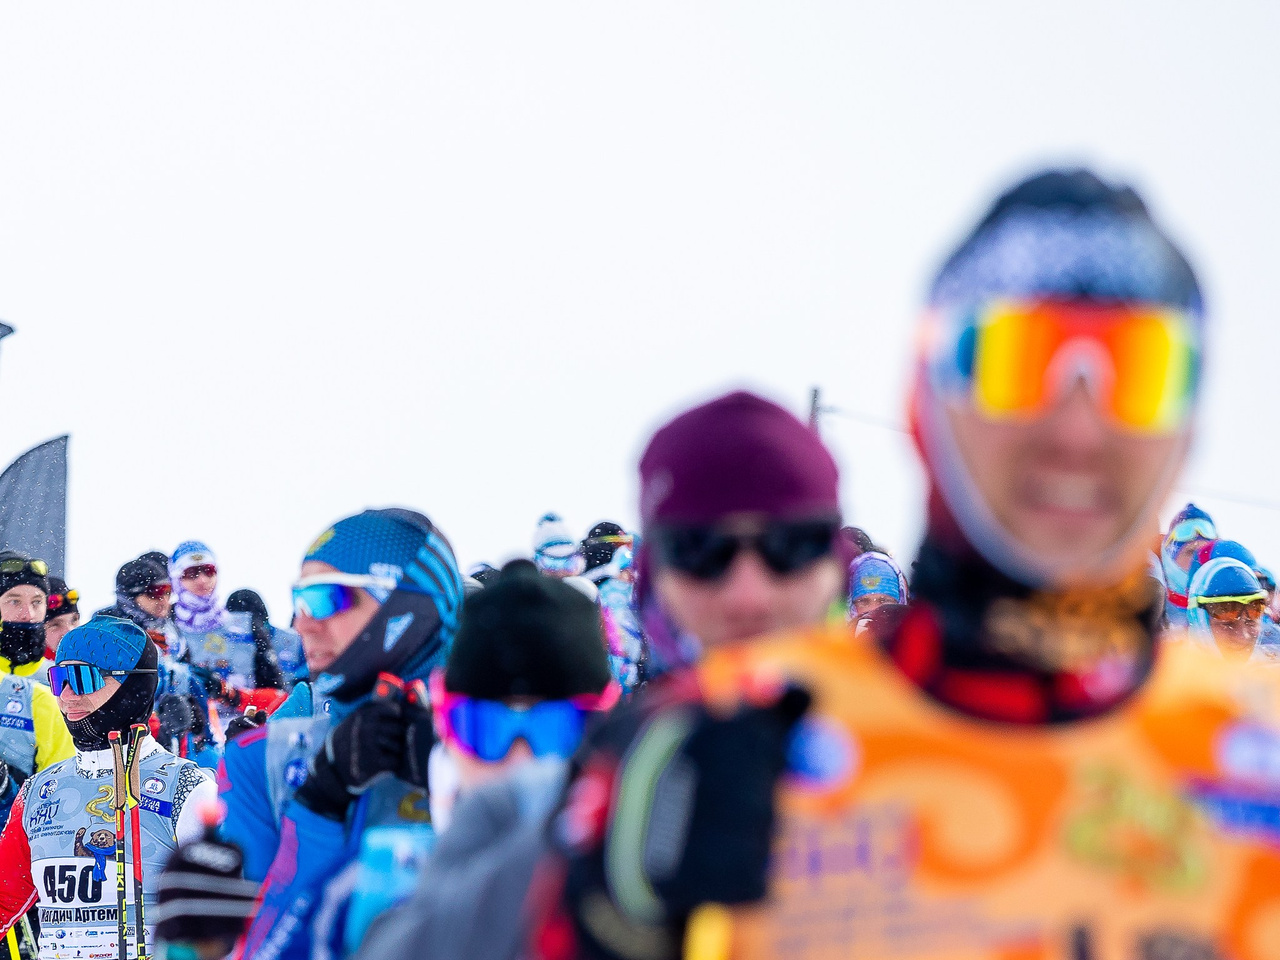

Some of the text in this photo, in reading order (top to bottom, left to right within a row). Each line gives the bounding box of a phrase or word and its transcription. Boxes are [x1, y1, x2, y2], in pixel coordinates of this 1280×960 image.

[43, 865, 103, 904] 450
[116, 850, 124, 891] LEKI
[75, 907, 118, 924] Артем
